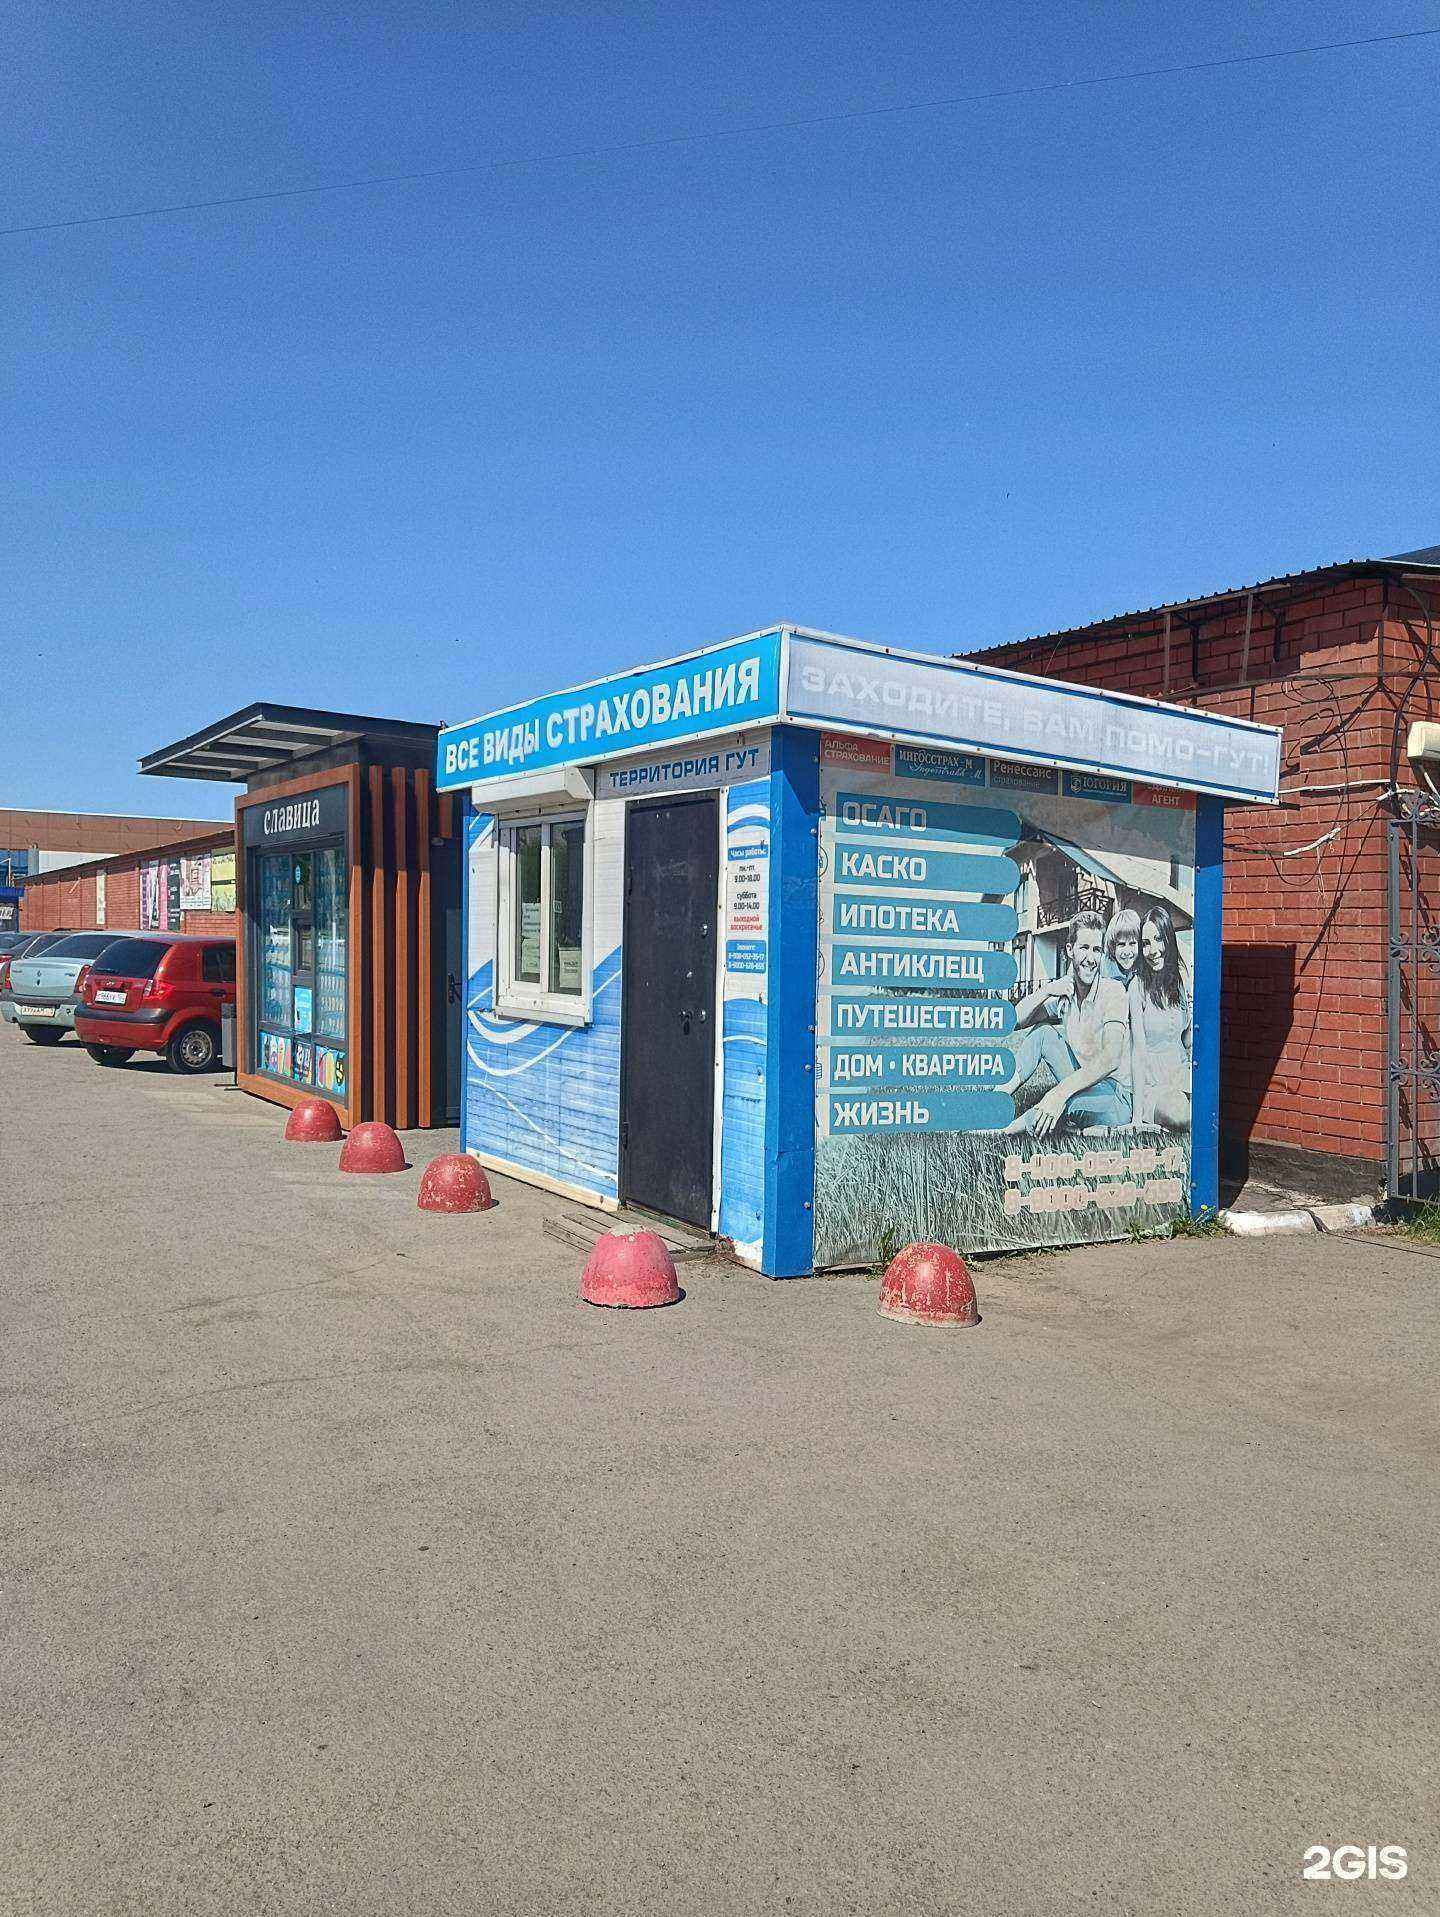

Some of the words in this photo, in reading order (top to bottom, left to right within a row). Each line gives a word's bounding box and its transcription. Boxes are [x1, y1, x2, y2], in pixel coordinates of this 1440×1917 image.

[445, 737, 480, 774] ВСЕ
[483, 718, 540, 766] ВИДЫ
[546, 656, 761, 749] СТРАХОВАНИЯ
[824, 739, 858, 751] АЛЬФА
[1023, 708, 1094, 741] ВАМ
[1105, 724, 1269, 774] ПОМО-ГУТ!
[609, 754, 719, 788] ТЕРРИТОРИЯ
[724, 748, 759, 772] ГУТ
[824, 750, 890, 765] СТРАХОВАНИЕ
[993, 761, 1052, 779] Ренессанс
[1151, 794, 1181, 806] АГЕНТ
[263, 799, 320, 835] славица
[842, 801, 928, 831] ОСАГО
[841, 853, 927, 880] КАСКО
[736, 891, 757, 900] суббота
[840, 903, 960, 933] ИПОТЕКА
[839, 952, 984, 983] АНТИКЛЕЩ
[837, 1003, 1005, 1029] ПУТЕШЕСТВИЯ
[834, 1053, 883, 1080] ДОМ
[901, 1053, 1005, 1076] КВАРТИРА
[833, 1100, 930, 1126] ЖИЗНЬ
